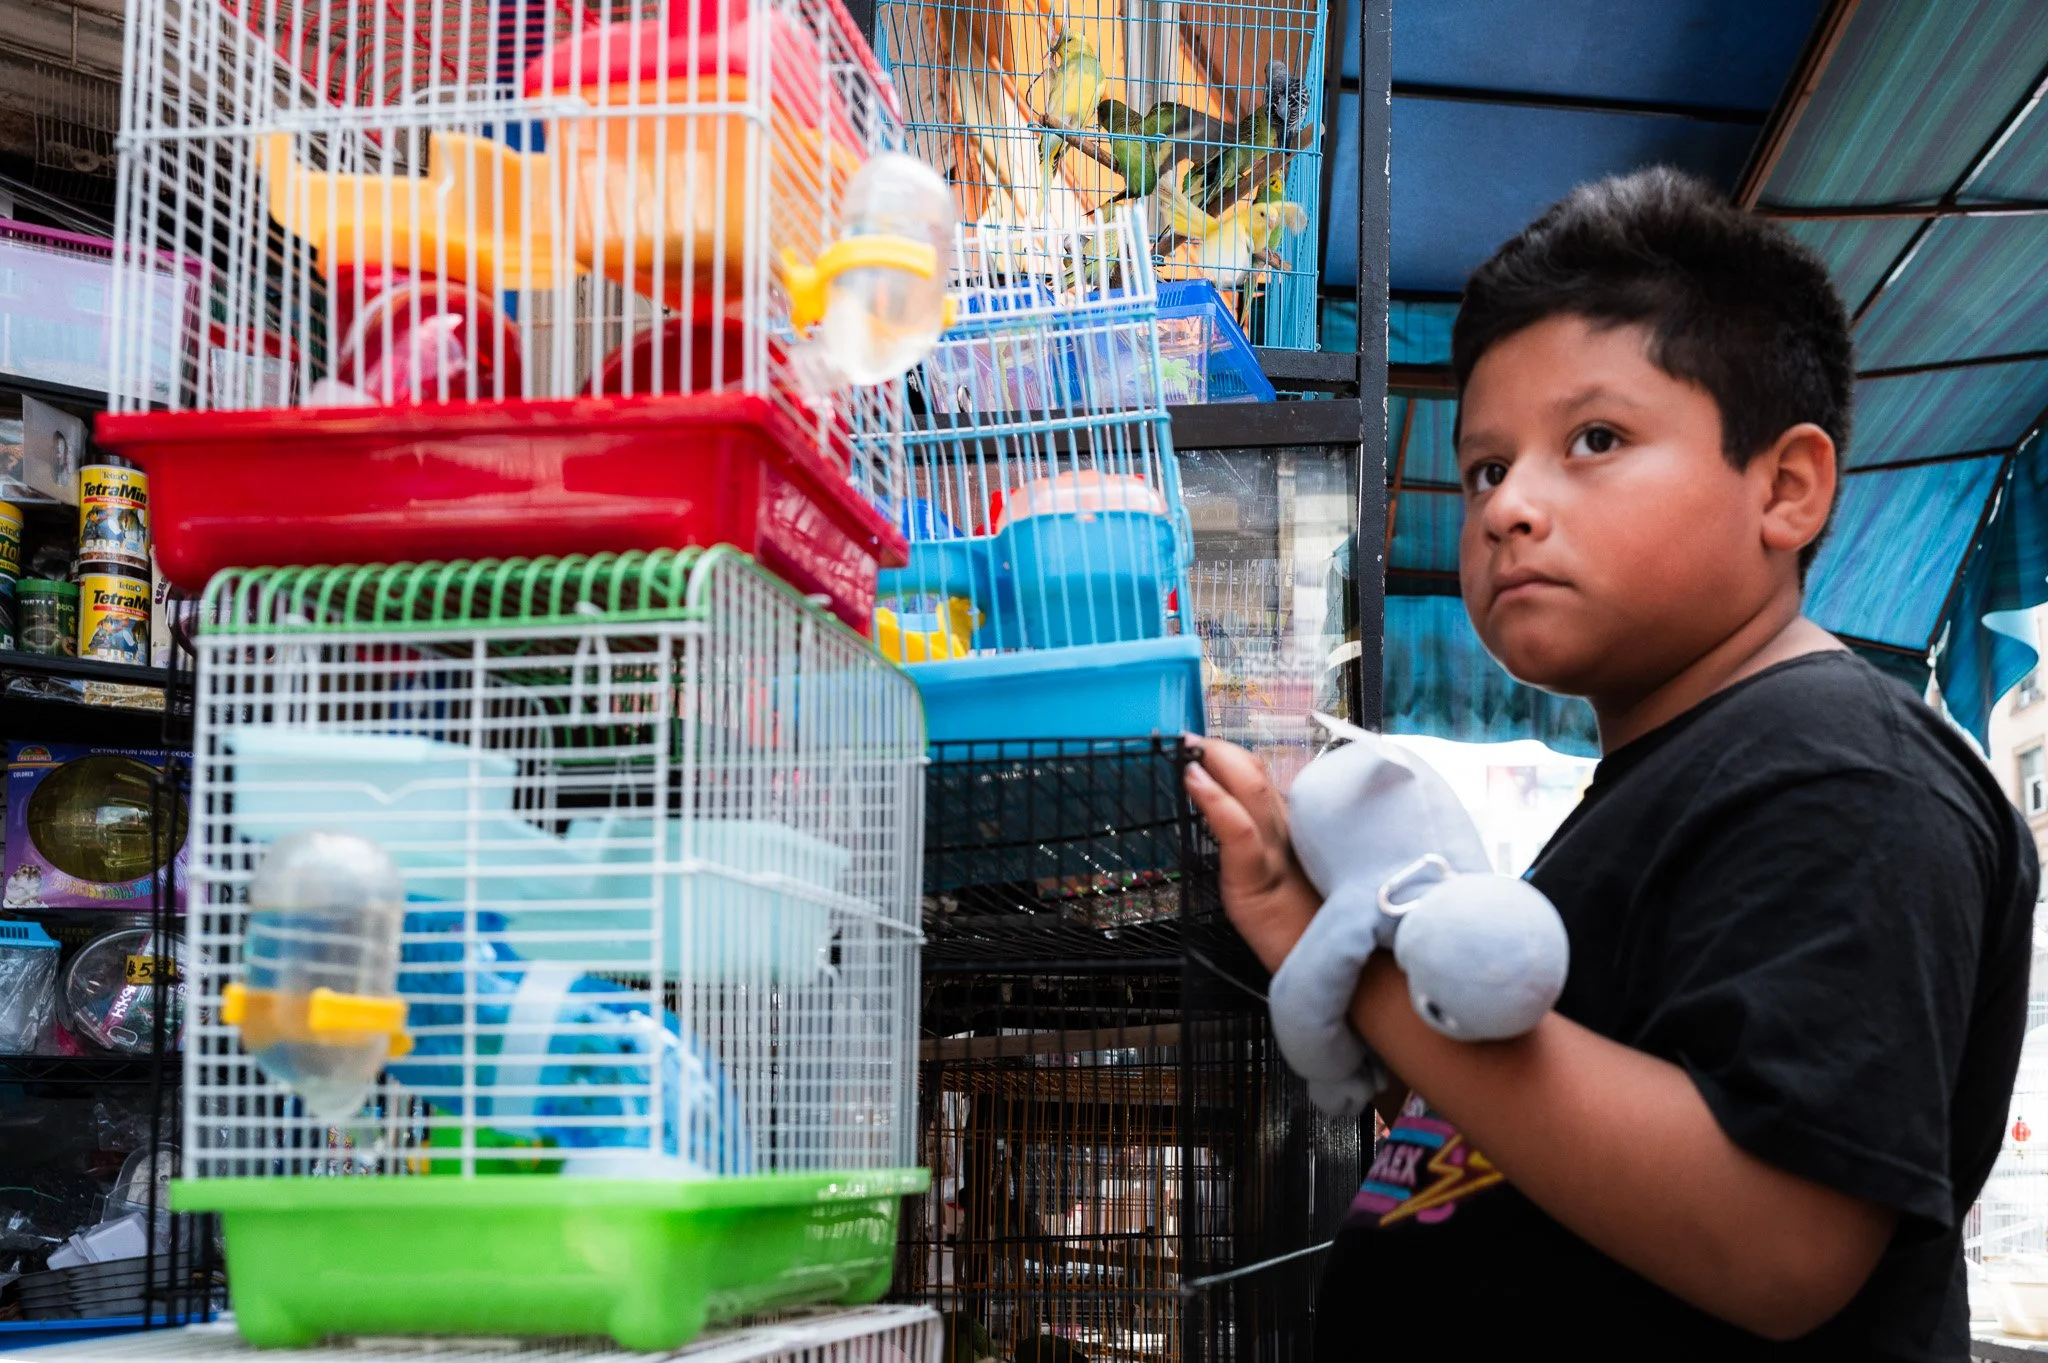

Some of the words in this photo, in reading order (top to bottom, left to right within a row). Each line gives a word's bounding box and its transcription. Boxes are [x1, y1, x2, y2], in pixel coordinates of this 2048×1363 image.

[103, 472, 121, 480] Tetra
[84, 482, 146, 504] TetraMin
[119, 582, 135, 591] Tetra
[140, 749, 158, 757] AND
[105, 885, 135, 900] BALL
